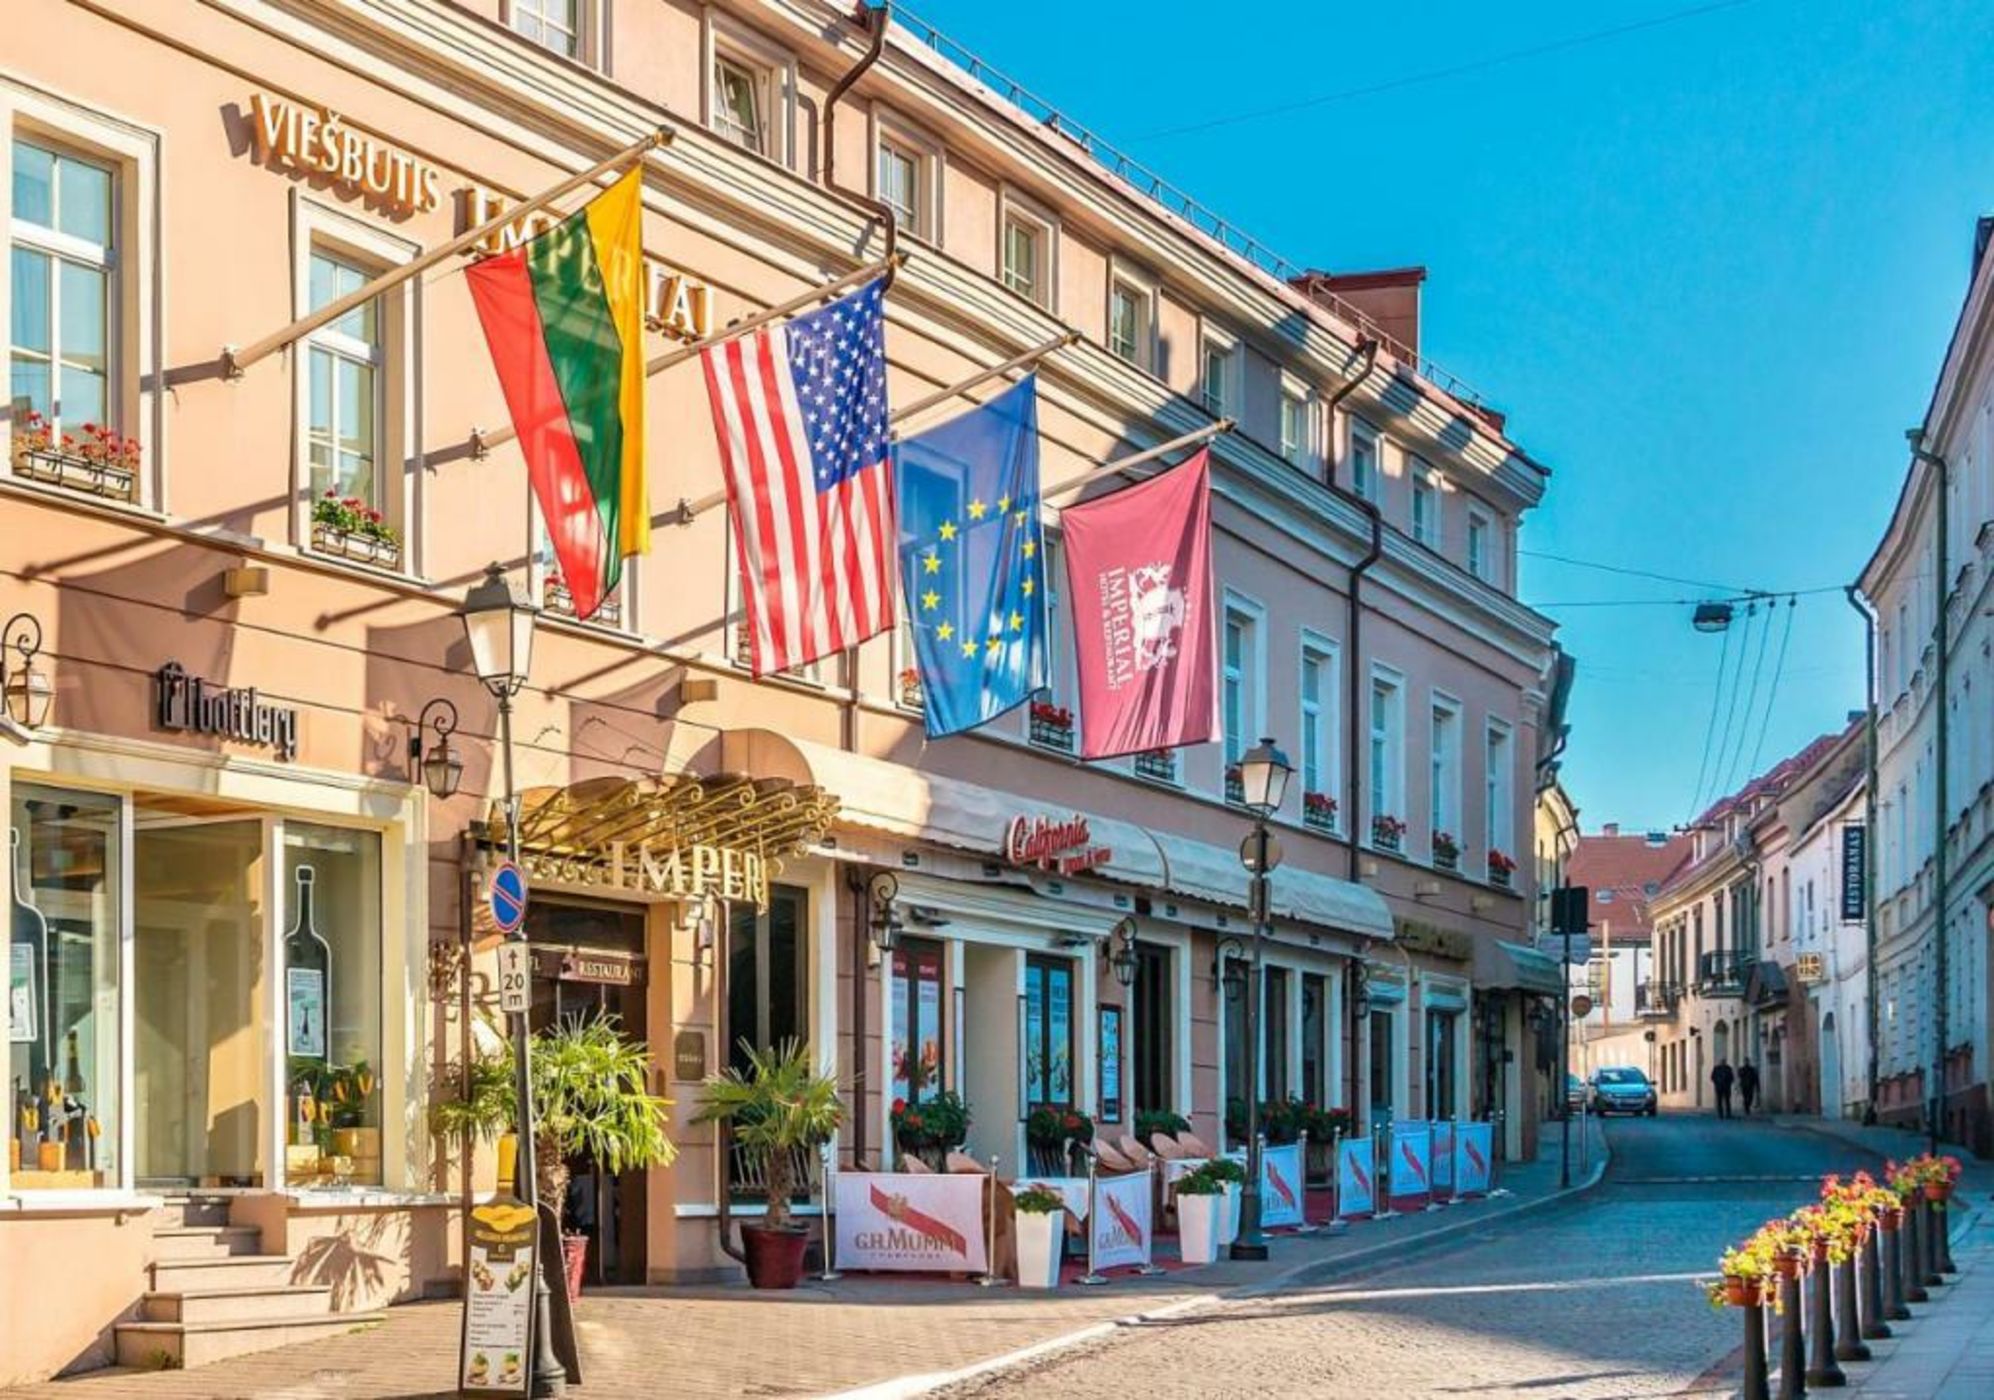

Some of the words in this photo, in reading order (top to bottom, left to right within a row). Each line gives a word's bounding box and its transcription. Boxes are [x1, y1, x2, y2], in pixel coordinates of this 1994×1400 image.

[252, 95, 441, 213] VIEŠBUTIS
[1108, 566, 1134, 688] IMPERIAL
[578, 960, 642, 979] RESTAURA
[504, 973, 524, 990] 20
[509, 994, 523, 1006] m
